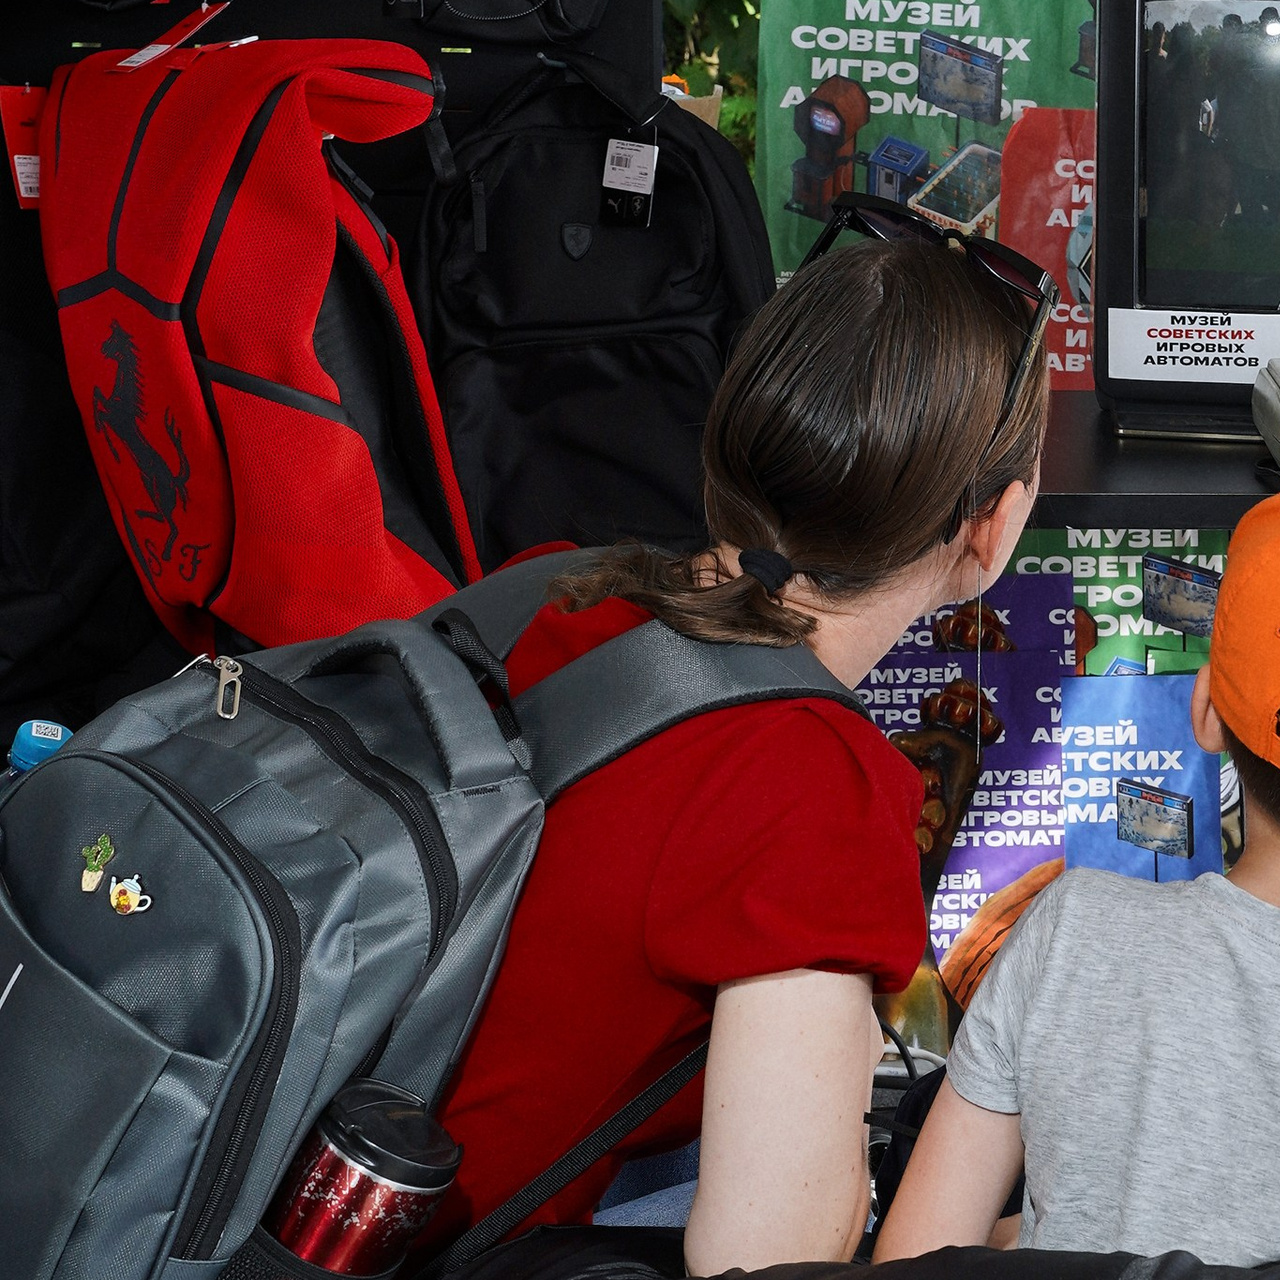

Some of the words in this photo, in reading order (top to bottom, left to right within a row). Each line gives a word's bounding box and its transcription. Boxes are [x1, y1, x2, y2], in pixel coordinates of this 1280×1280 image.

[810, 56, 1008, 91] ИГРО
[1170, 312, 1232, 326] МУЗЕЙ
[1146, 328, 1255, 340] СОВЕТСКИХ
[1156, 342, 1246, 354] ИГРОВЫХ
[1143, 355, 1259, 367] АВТОМАТОВ
[869, 663, 963, 684] МУЗЕЙ
[936, 869, 981, 890] ЗЕЙ
